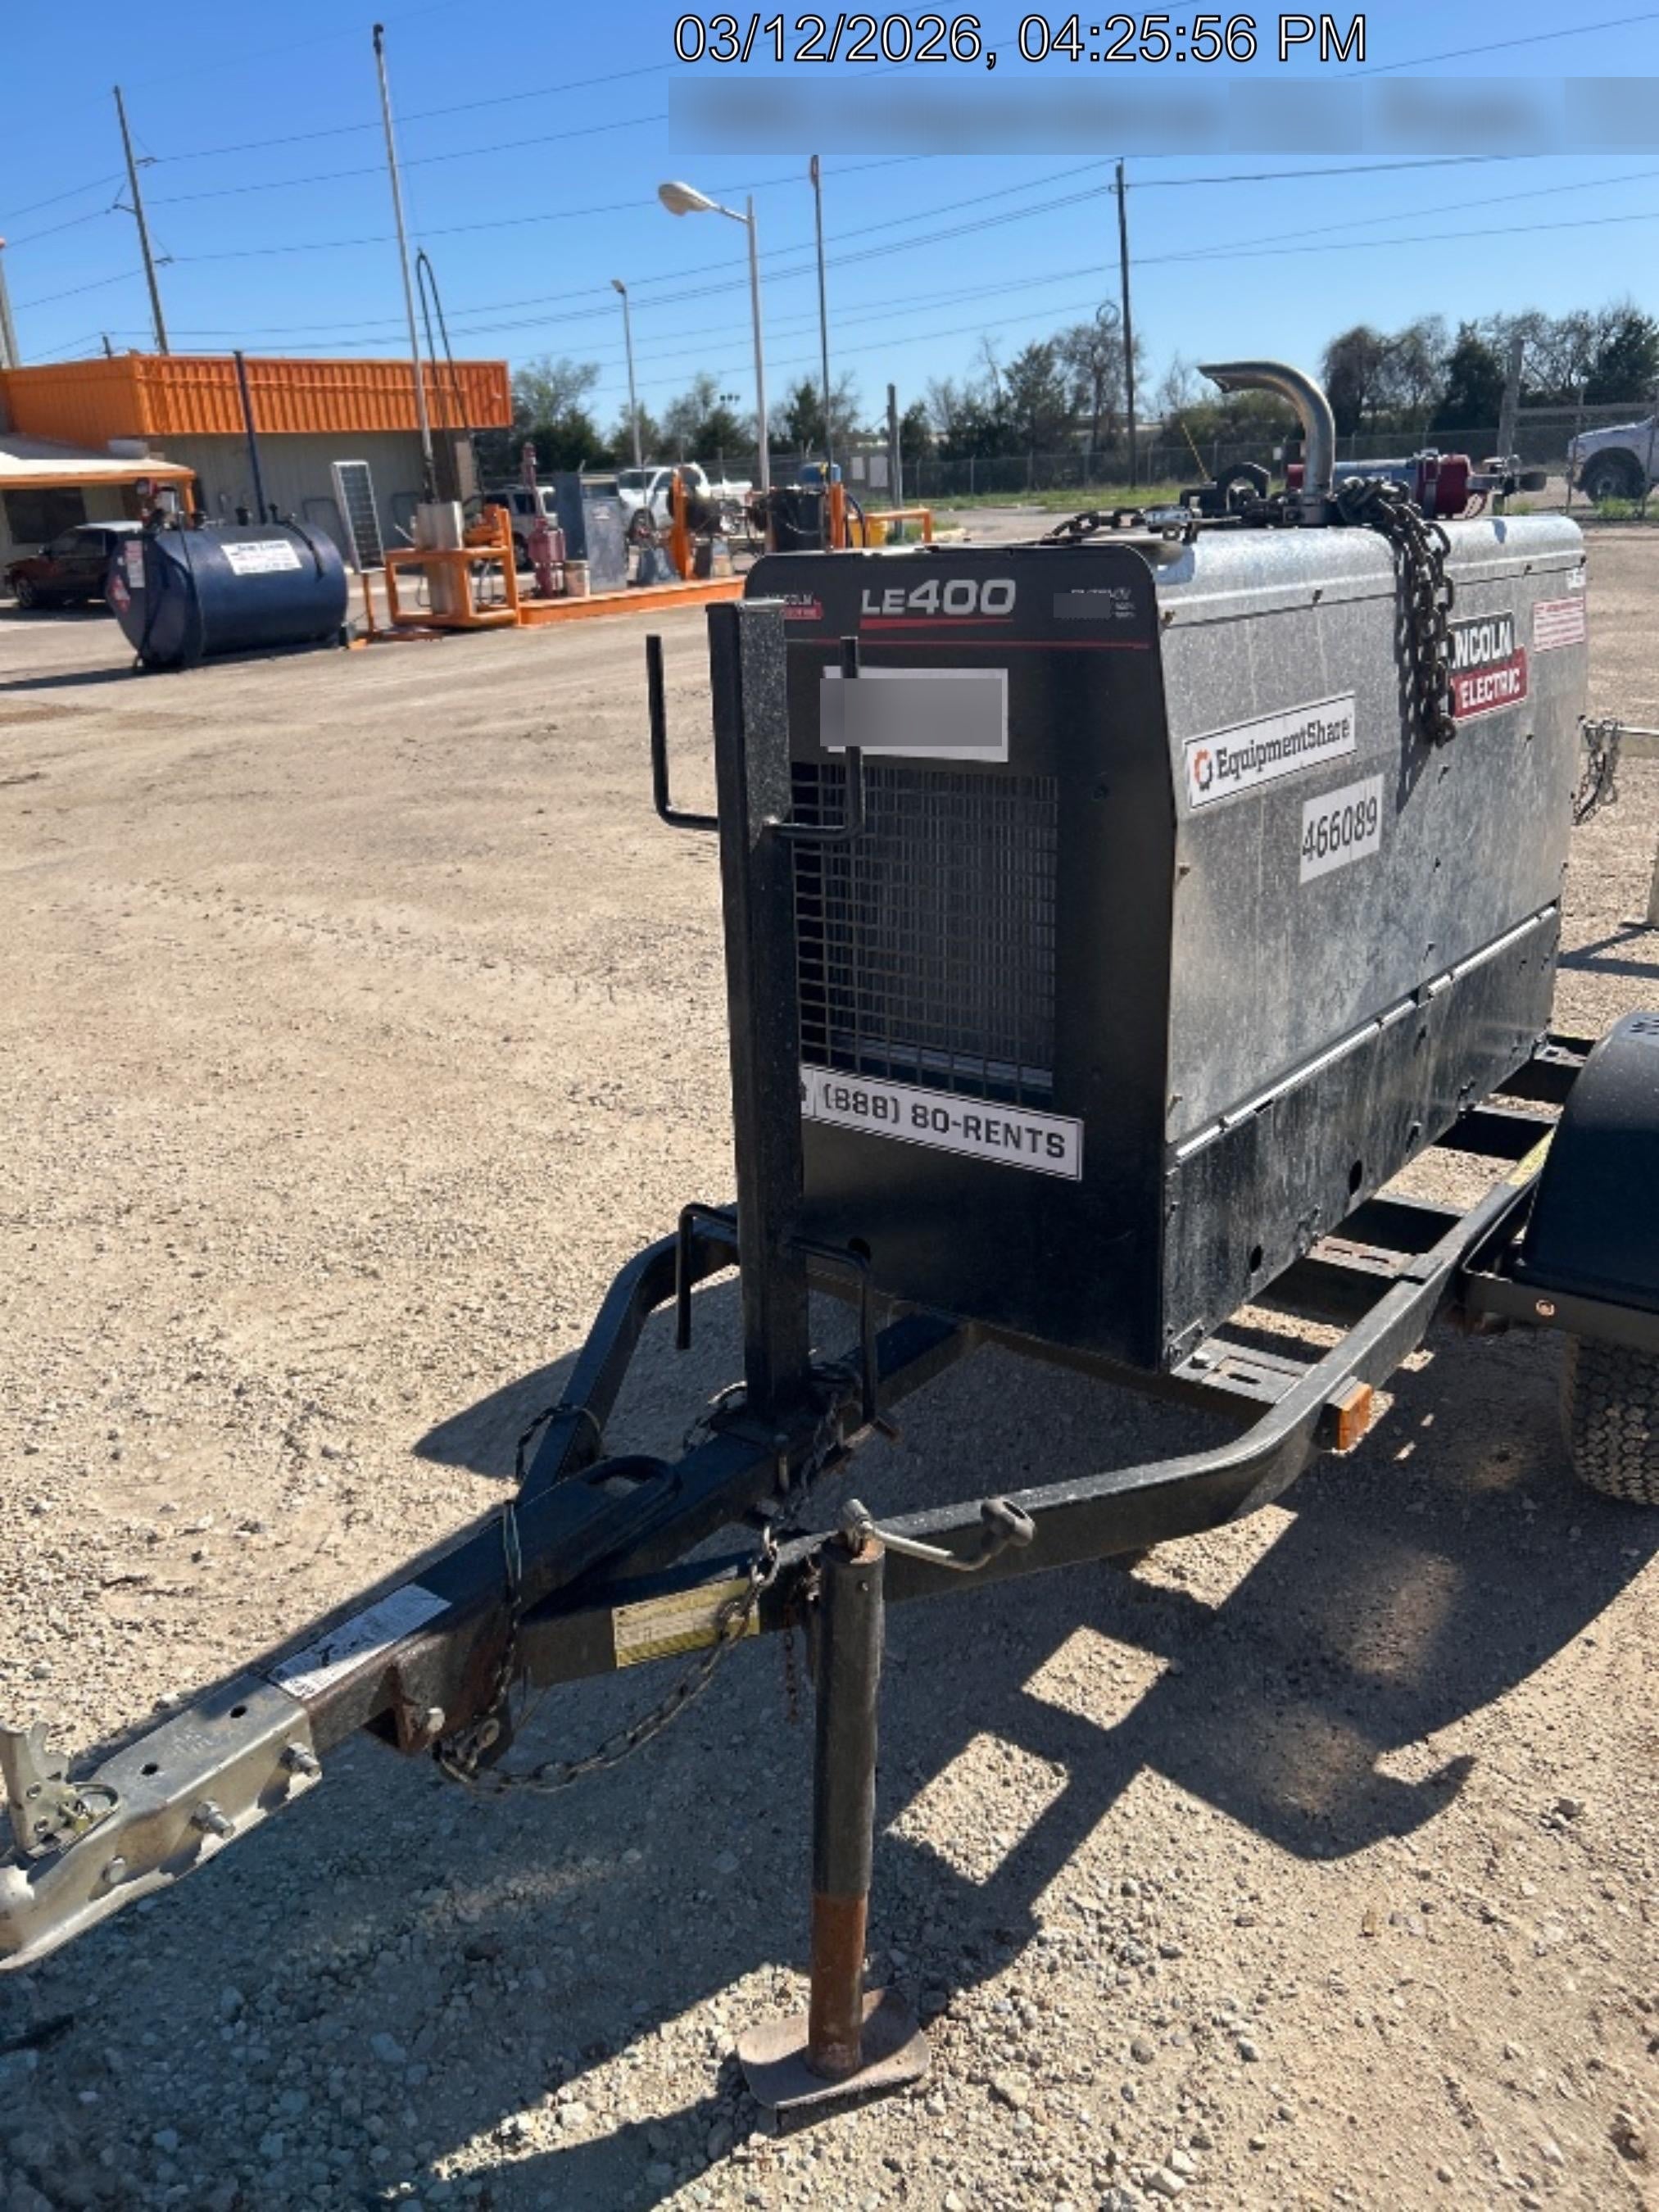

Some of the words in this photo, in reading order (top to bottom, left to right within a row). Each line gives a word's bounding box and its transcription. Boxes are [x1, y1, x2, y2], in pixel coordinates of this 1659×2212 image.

[862, 579, 1017, 614] LE400
[1460, 668, 1521, 709] ELECTRIC
[1216, 715, 1350, 781] EquipmentShare
[1302, 796, 1378, 862] 466089
[823, 1083, 900, 1124] (888)
[911, 1103, 1066, 1158] 80-RENTS
